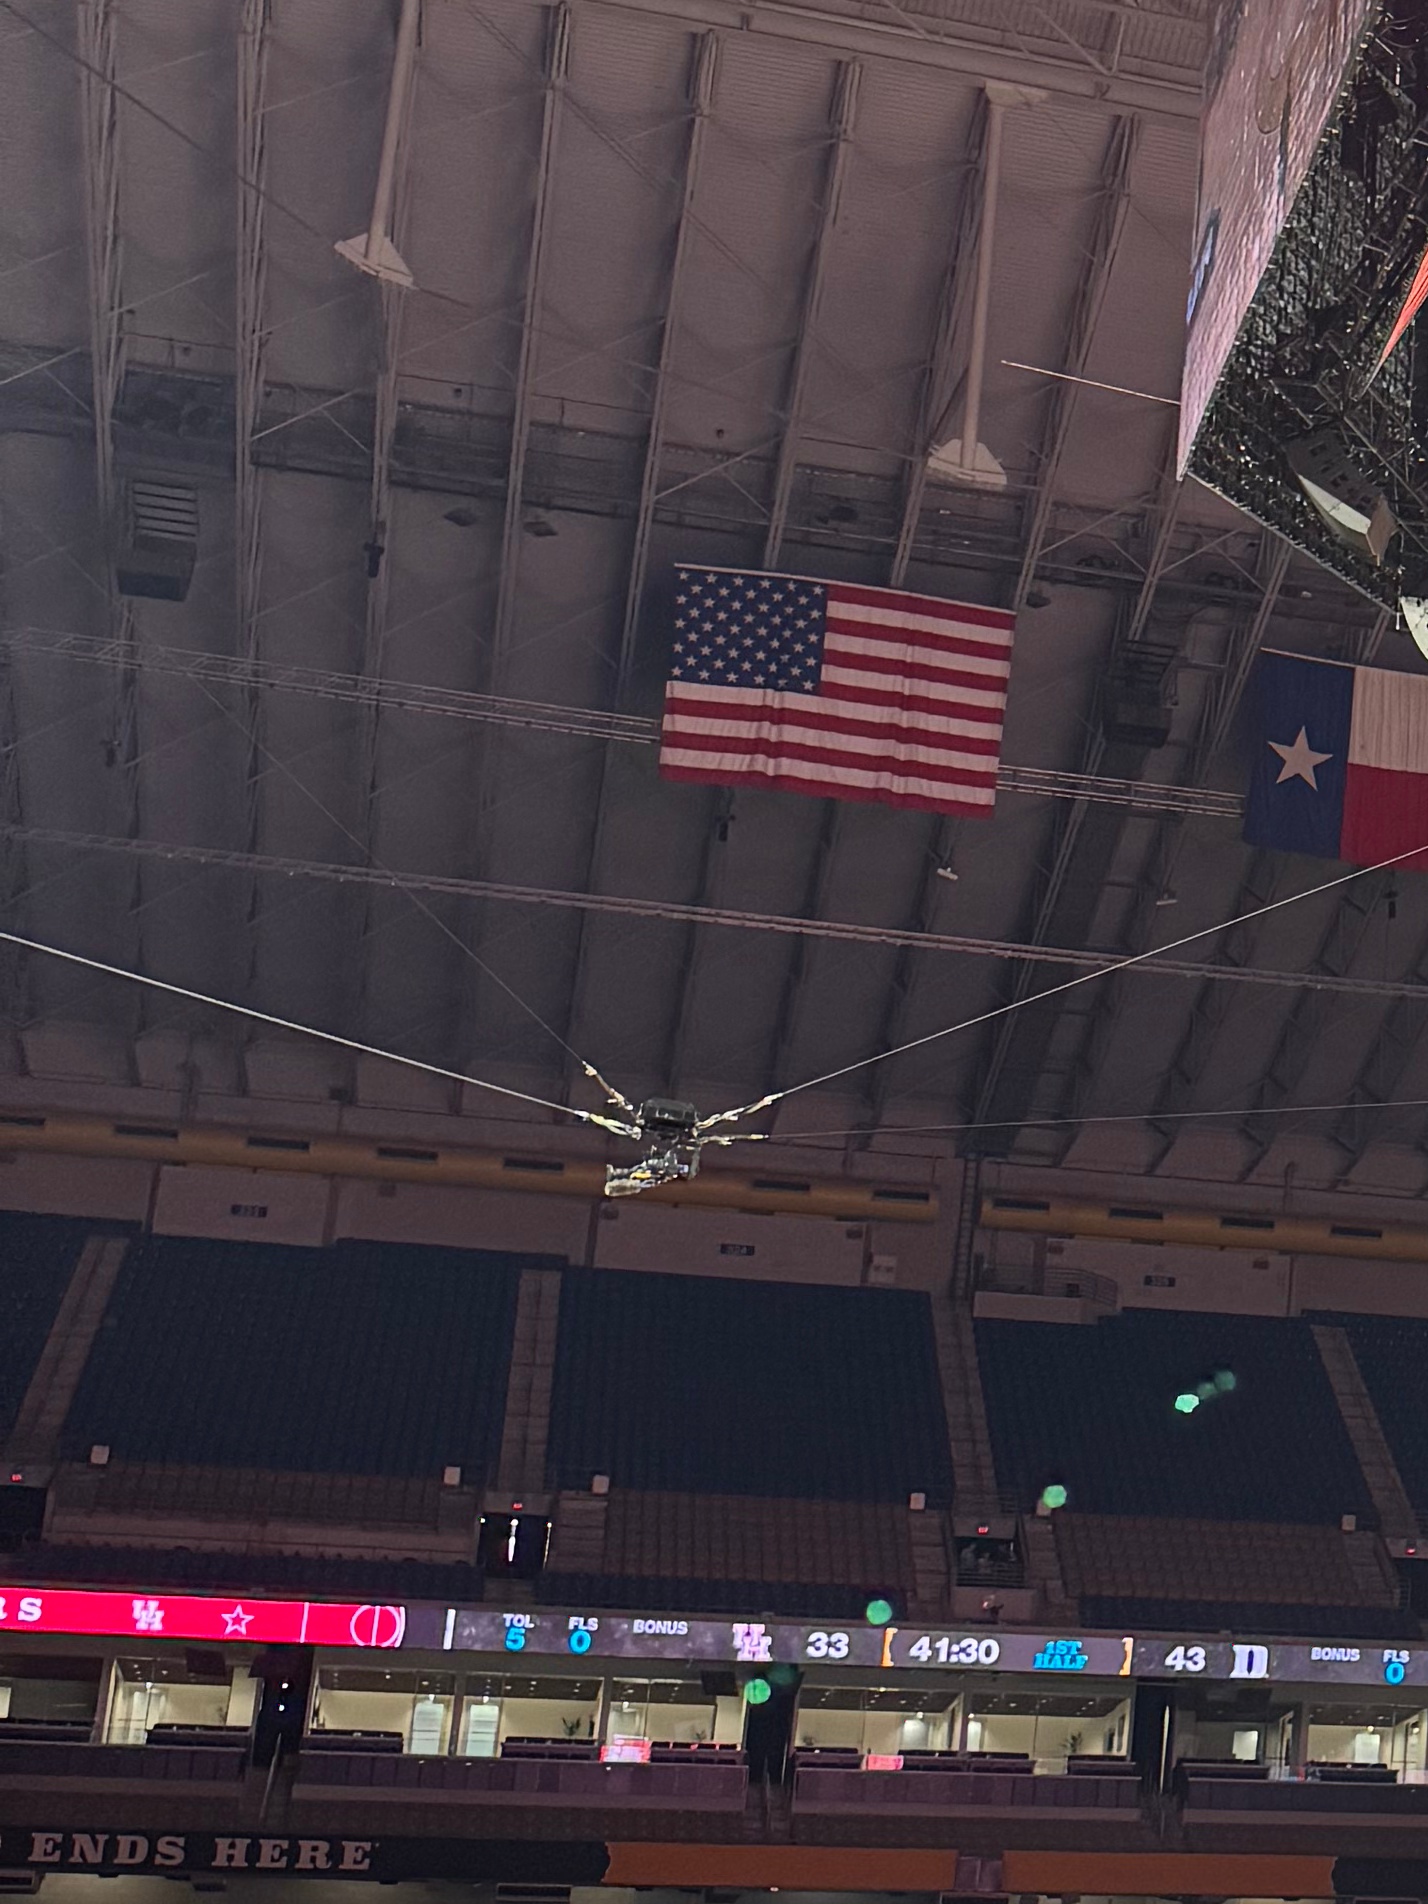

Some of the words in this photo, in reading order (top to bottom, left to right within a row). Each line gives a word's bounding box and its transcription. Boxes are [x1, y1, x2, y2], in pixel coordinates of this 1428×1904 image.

[503, 1613, 535, 1628] TOL
[568, 1616, 598, 1631] FLS
[632, 1618, 688, 1635] BONUS
[505, 1628, 526, 1652] 5
[568, 1629, 592, 1654] 0
[806, 1631, 850, 1659] 33
[908, 1636, 1000, 1664] 41:30
[1044, 1640, 1083, 1654] 1ST
[1032, 1653, 1089, 1670] HALF
[1164, 1646, 1207, 1672] 43
[1311, 1647, 1360, 1662] BONUS
[1383, 1649, 1410, 1663] FLS
[1384, 1662, 1405, 1685] 0
[27, 1832, 186, 1865] ENDS
[211, 1838, 372, 1870] HERE
